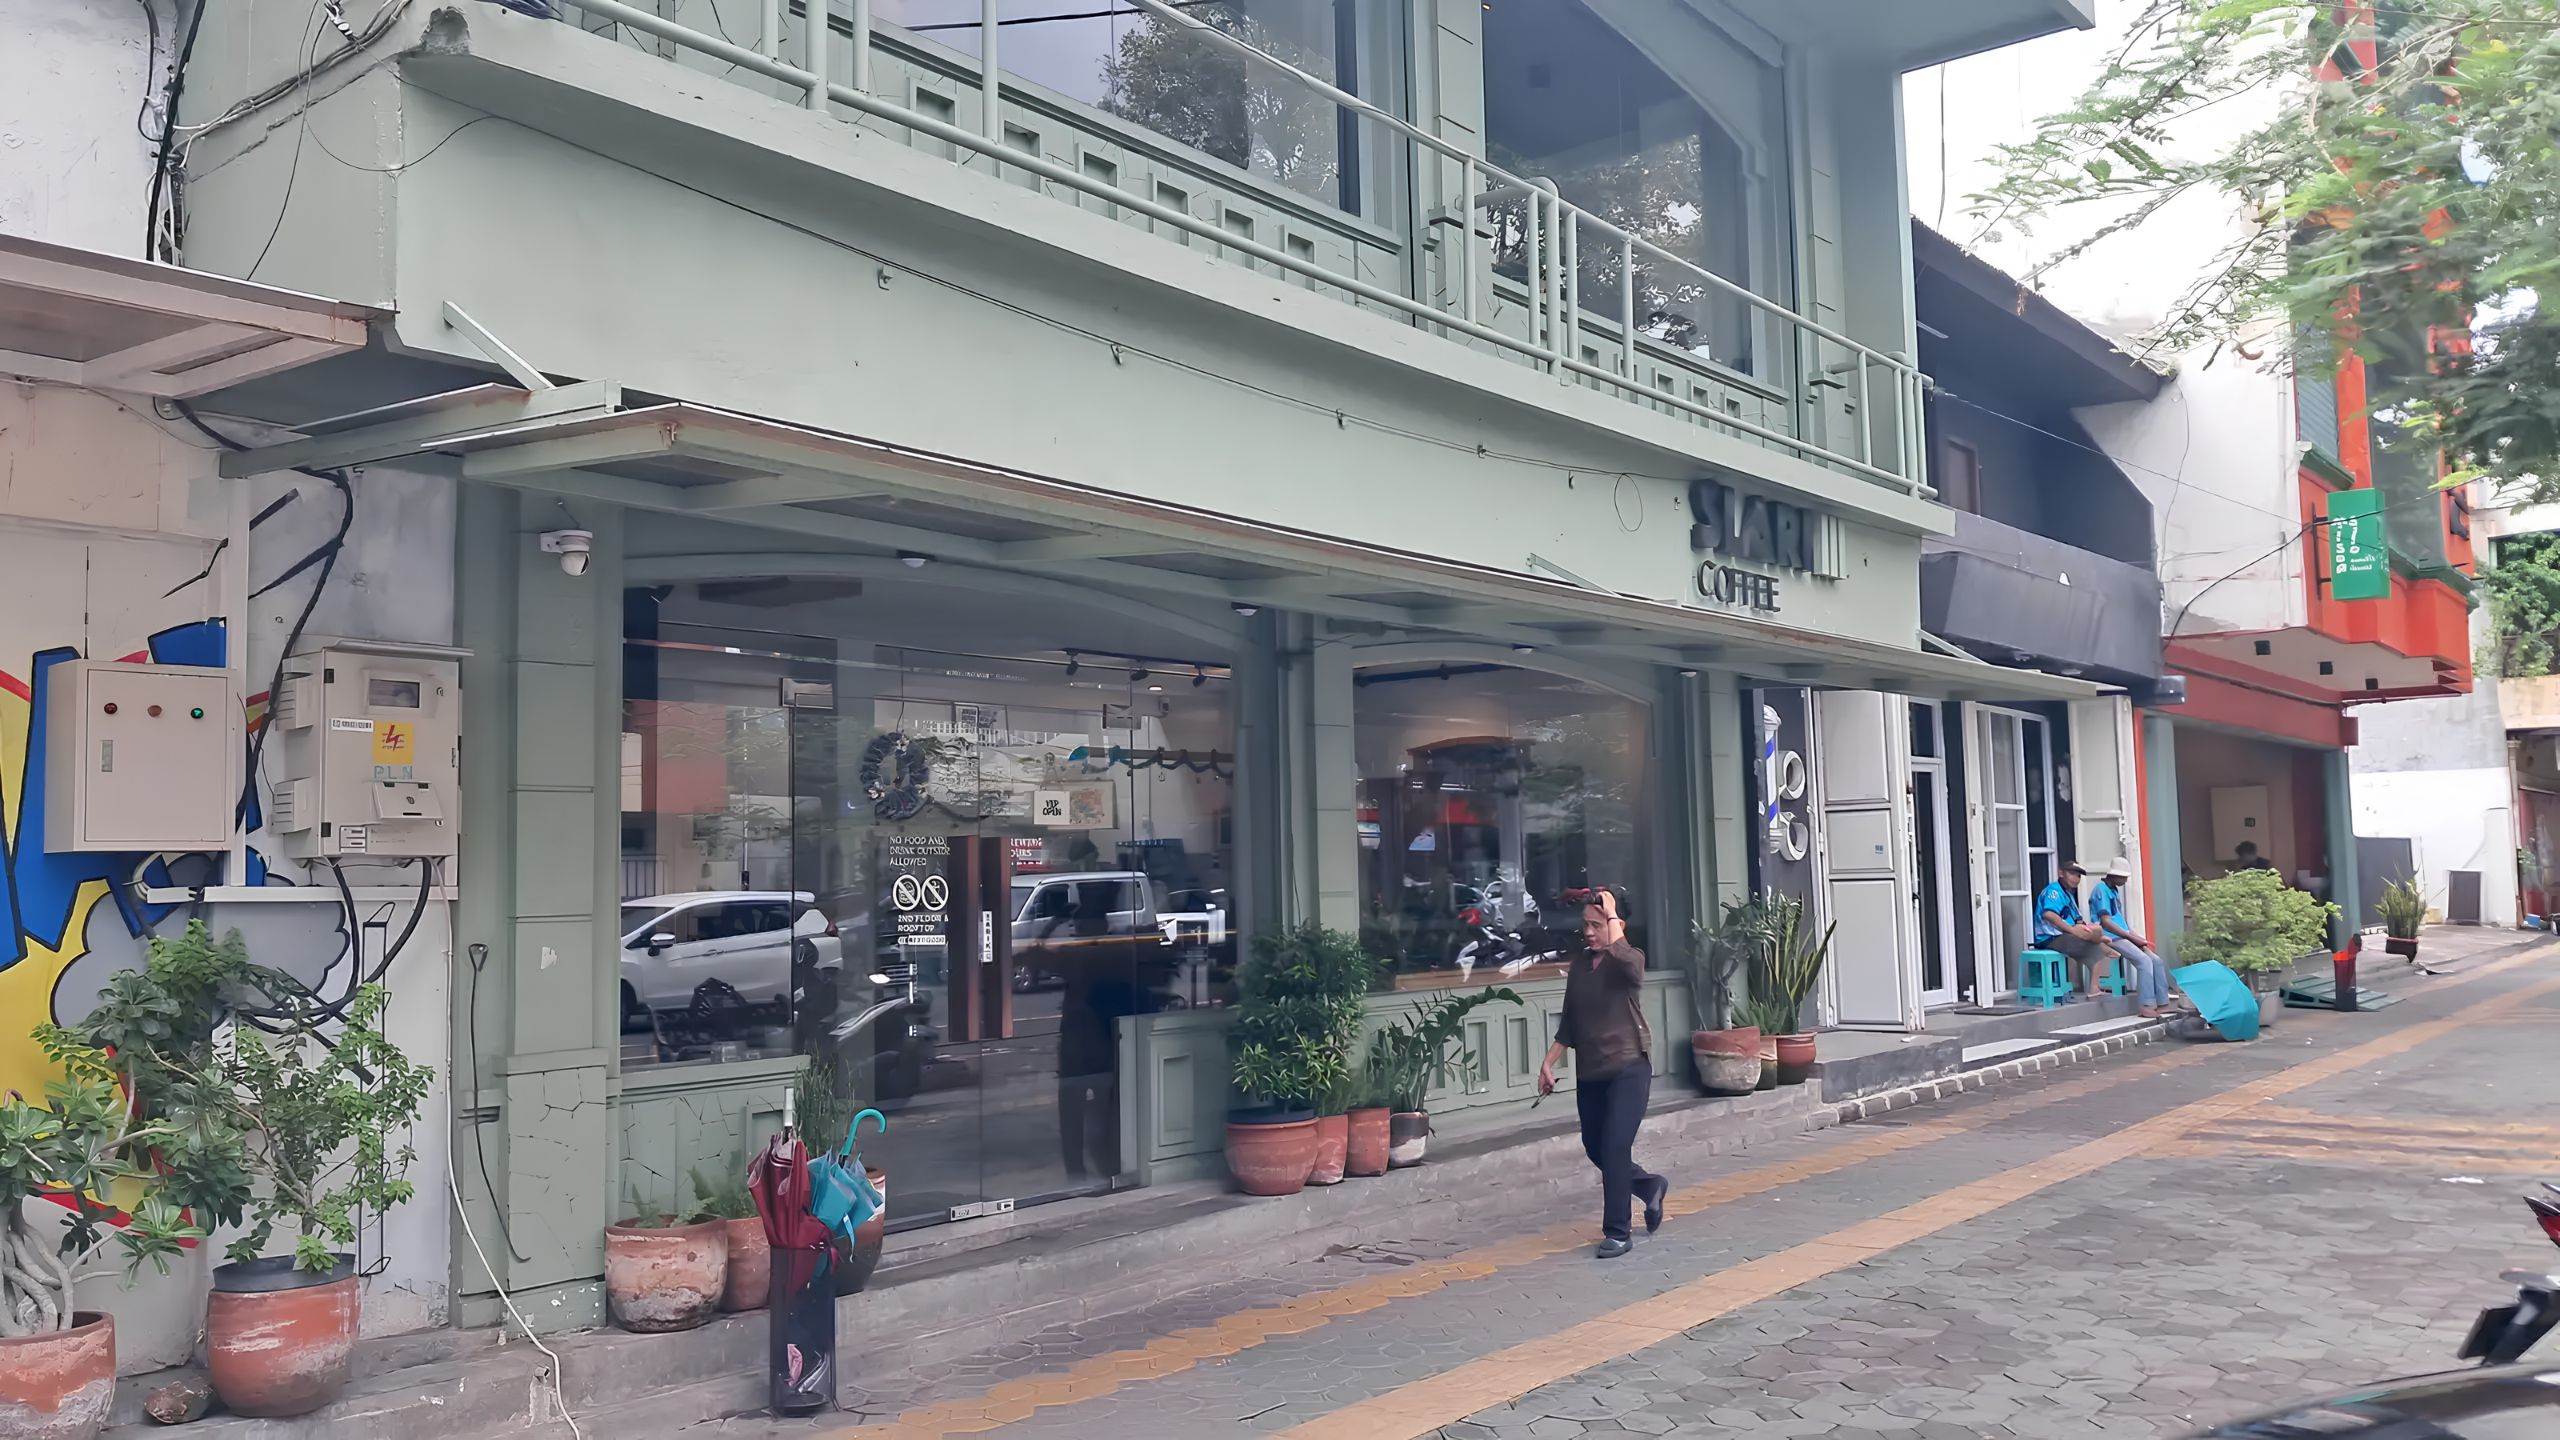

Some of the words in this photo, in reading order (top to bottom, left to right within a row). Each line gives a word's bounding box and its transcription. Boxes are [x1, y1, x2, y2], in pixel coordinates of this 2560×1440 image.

[1697, 560, 1781, 613] COFFEE
[374, 765, 413, 780] PLN
[1042, 807, 1062, 816] OPEN
[889, 836, 901, 844] NO
[904, 836, 926, 845] FOOD
[928, 836, 945, 845] AND
[917, 846, 951, 855] OUTSIDE
[889, 857, 927, 866] ALLOWED
[898, 914, 914, 922] 2ND
[915, 914, 941, 923] FLOOR
